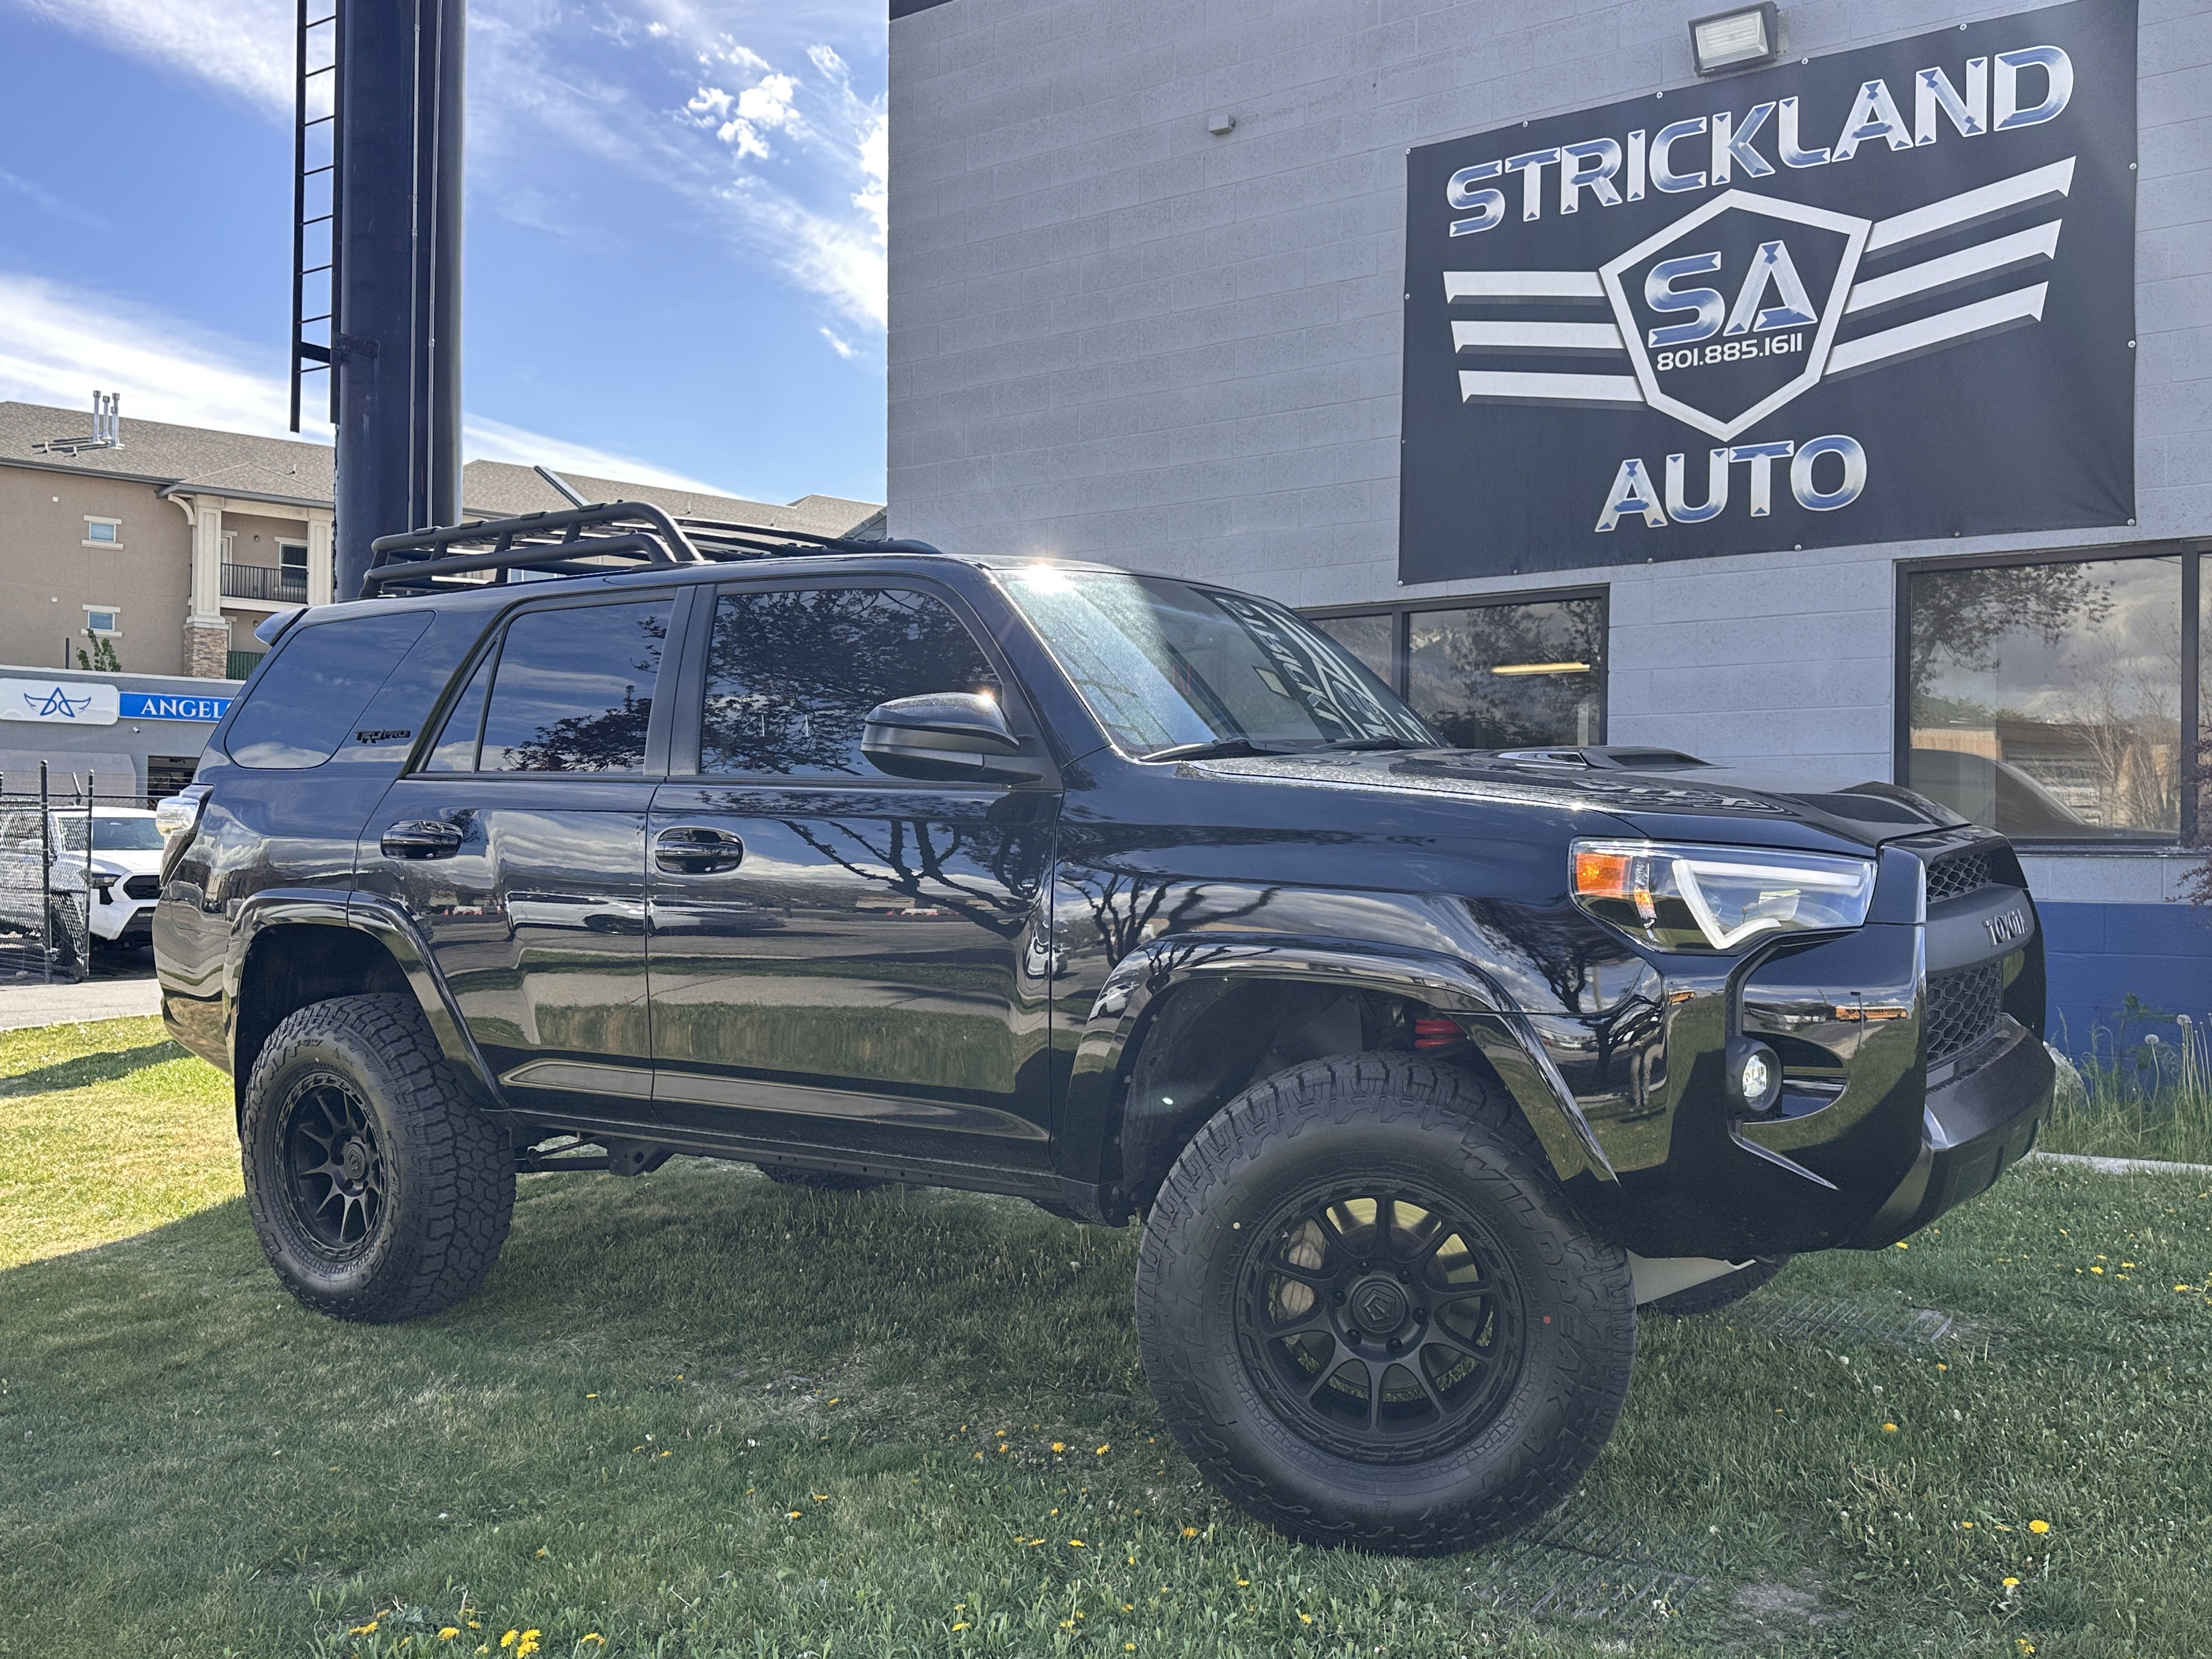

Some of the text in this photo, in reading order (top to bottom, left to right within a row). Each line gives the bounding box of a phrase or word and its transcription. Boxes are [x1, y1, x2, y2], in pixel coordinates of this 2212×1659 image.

[1446, 44, 2074, 238] STRICKLAND
[1645, 240, 1818, 348] SA
[1657, 332, 1802, 371] 801.885.1611
[1594, 435, 1867, 532] AUTO
[355, 729, 411, 744] TRD PRO
[1442, 1148, 1582, 1402] WILDPEAK
